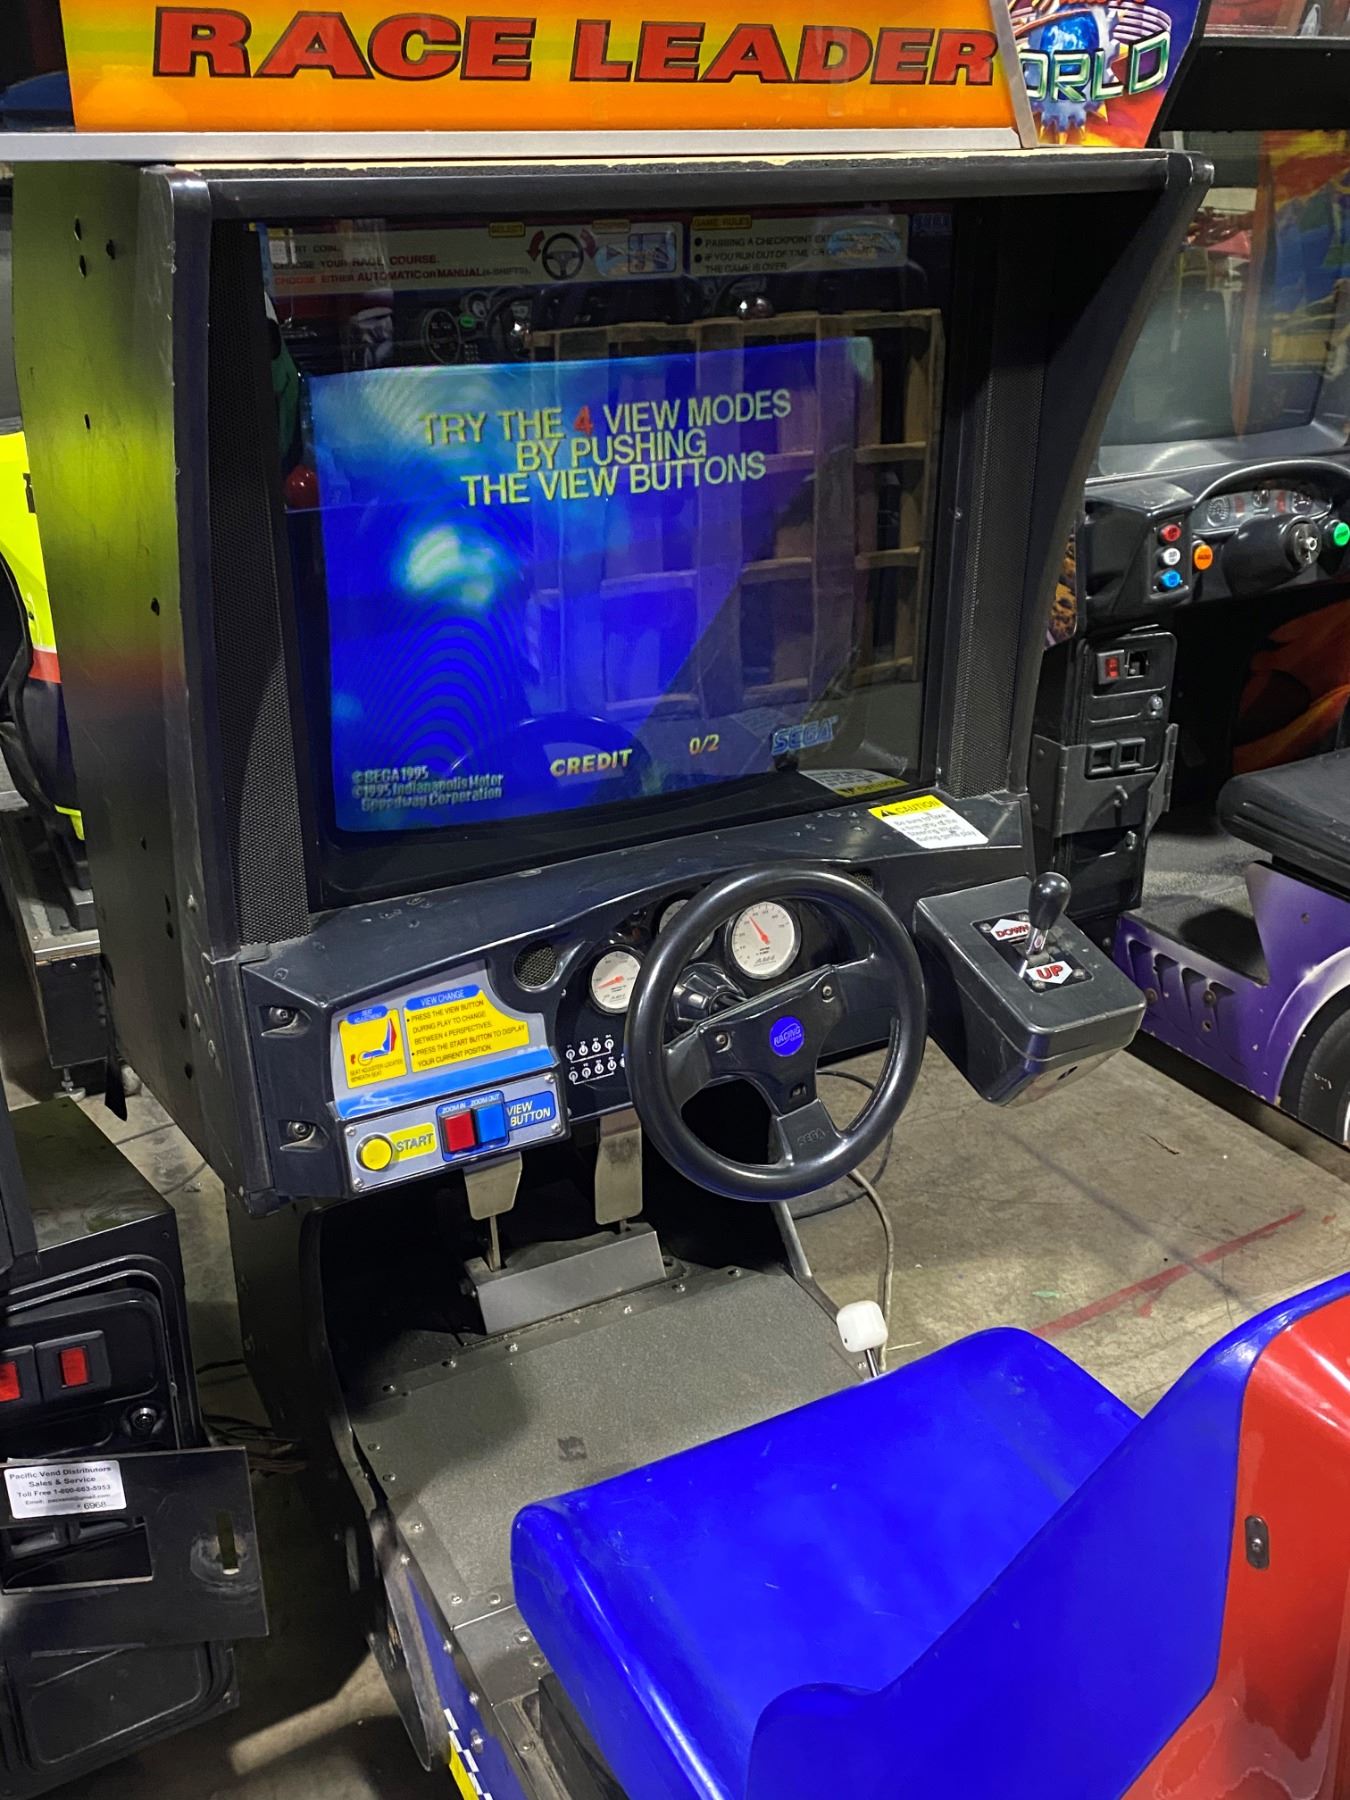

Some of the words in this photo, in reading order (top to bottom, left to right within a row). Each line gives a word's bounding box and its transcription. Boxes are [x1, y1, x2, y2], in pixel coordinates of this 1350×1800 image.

[153, 7, 536, 81] RACE
[570, 20, 998, 86] LEADER
[1019, 30, 1170, 102] ORLD
[357, 270, 421, 282] AUTOMATIC
[419, 412, 487, 445] TRY
[498, 407, 566, 441] THE
[573, 405, 593, 435] 4
[603, 398, 681, 435] VIEW
[687, 389, 792, 428] MODES
[516, 440, 560, 473] BY
[570, 428, 708, 468] PUSHING
[460, 472, 531, 506] THE
[537, 464, 619, 502] VIEW
[630, 452, 767, 494] BUTTONS
[688, 733, 721, 756] 0/2
[771, 718, 834, 756] SEGA
[550, 748, 634, 777] CREDIT
[469, 772, 504, 789] Motor
[428, 786, 503, 808] Corporation
[895, 799, 942, 813] CAUTION
[995, 924, 1030, 938] DOWN
[1036, 964, 1064, 979] UP
[420, 997, 437, 1007] VIEW
[437, 989, 465, 1004] CHANGE
[411, 1012, 431, 1022] PRESS
[432, 1009, 444, 1018] THE
[444, 1006, 460, 1016] VIEW
[460, 1000, 484, 1012] BUTTON
[412, 1022, 436, 1034] DURING
[437, 1019, 451, 1029] PLAY
[453, 1016, 462, 1024] TO
[461, 1010, 487, 1022] CHANGE
[414, 1033, 443, 1046] BETWEEN
[416, 1046, 437, 1056] PRESS
[437, 1043, 449, 1051] THE
[449, 1037, 468, 1048] START
[469, 1032, 493, 1045] BUTTON
[493, 1030, 502, 1038] TO
[502, 1024, 525, 1036] DISPLAY
[773, 1026, 801, 1046] RACING
[418, 1058, 435, 1068] YOUR
[435, 1050, 464, 1064] CURRENT
[442, 1103, 459, 1114] ZOOM
[507, 1100, 533, 1116] VIEW
[510, 1107, 551, 1127] BUTTON
[396, 1132, 434, 1153] START
[9, 1471, 37, 1480] Pacific
[39, 1469, 61, 1478] Vend
[62, 1466, 112, 1476] Distributors
[28, 1480, 53, 1488] Sales
[63, 1476, 96, 1485] Service
[34, 1488, 51, 1496] Free
